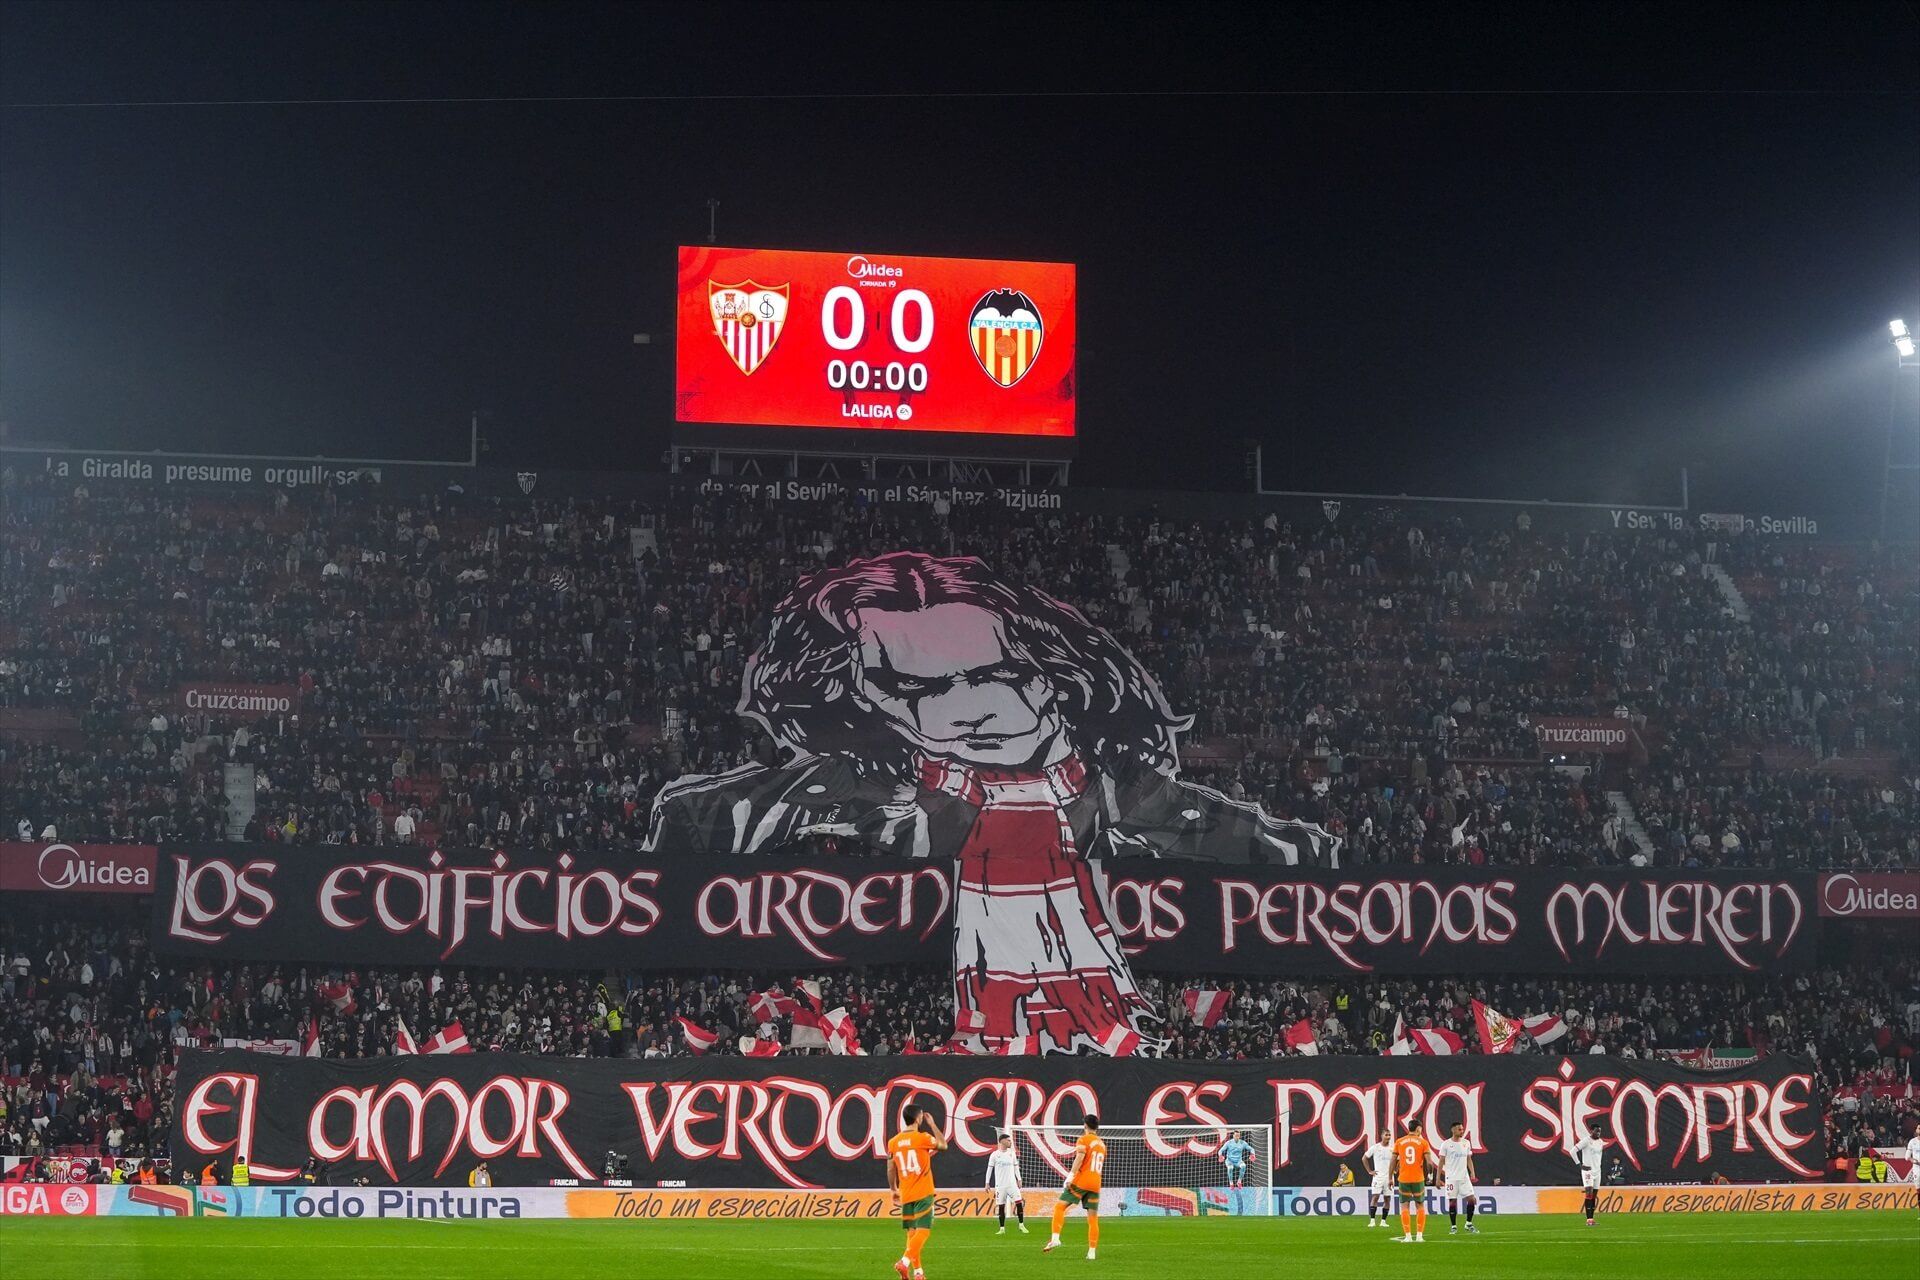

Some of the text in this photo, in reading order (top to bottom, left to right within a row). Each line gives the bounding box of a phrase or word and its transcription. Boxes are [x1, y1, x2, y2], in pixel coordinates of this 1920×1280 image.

[847, 256, 903, 278] Midea
[859, 280, 897, 289] JORNADA 19
[822, 286, 934, 354] 0 0
[975, 320, 1019, 329] VALENCIA
[827, 359, 928, 392] 00:00
[841, 403, 894, 419] LALIGA
[82, 457, 153, 480] Giralda
[165, 463, 252, 484] presume
[884, 486, 901, 503] el
[1610, 510, 1622, 528] Y
[186, 688, 290, 712] Cruzcampo
[37, 844, 150, 889] Midea
[1823, 873, 1918, 915] Midea
[895, 1149, 922, 1178] 14
[1405, 1146, 1416, 1165] 9
[67, 1192, 83, 1202] EA
[271, 1188, 521, 1219] Todo Pintura
[614, 1191, 664, 1218] Todo
[672, 1199, 697, 1218] un
[707, 1193, 859, 1219] especialista
[867, 1198, 882, 1217] a
[1273, 1189, 1355, 1216] Todo
[1580, 1190, 1623, 1213] odo
[1630, 1195, 1657, 1212] un
[1662, 1189, 1796, 1214] especialista
[1802, 1194, 1816, 1211] a
[1820, 1192, 1851, 1210] su
